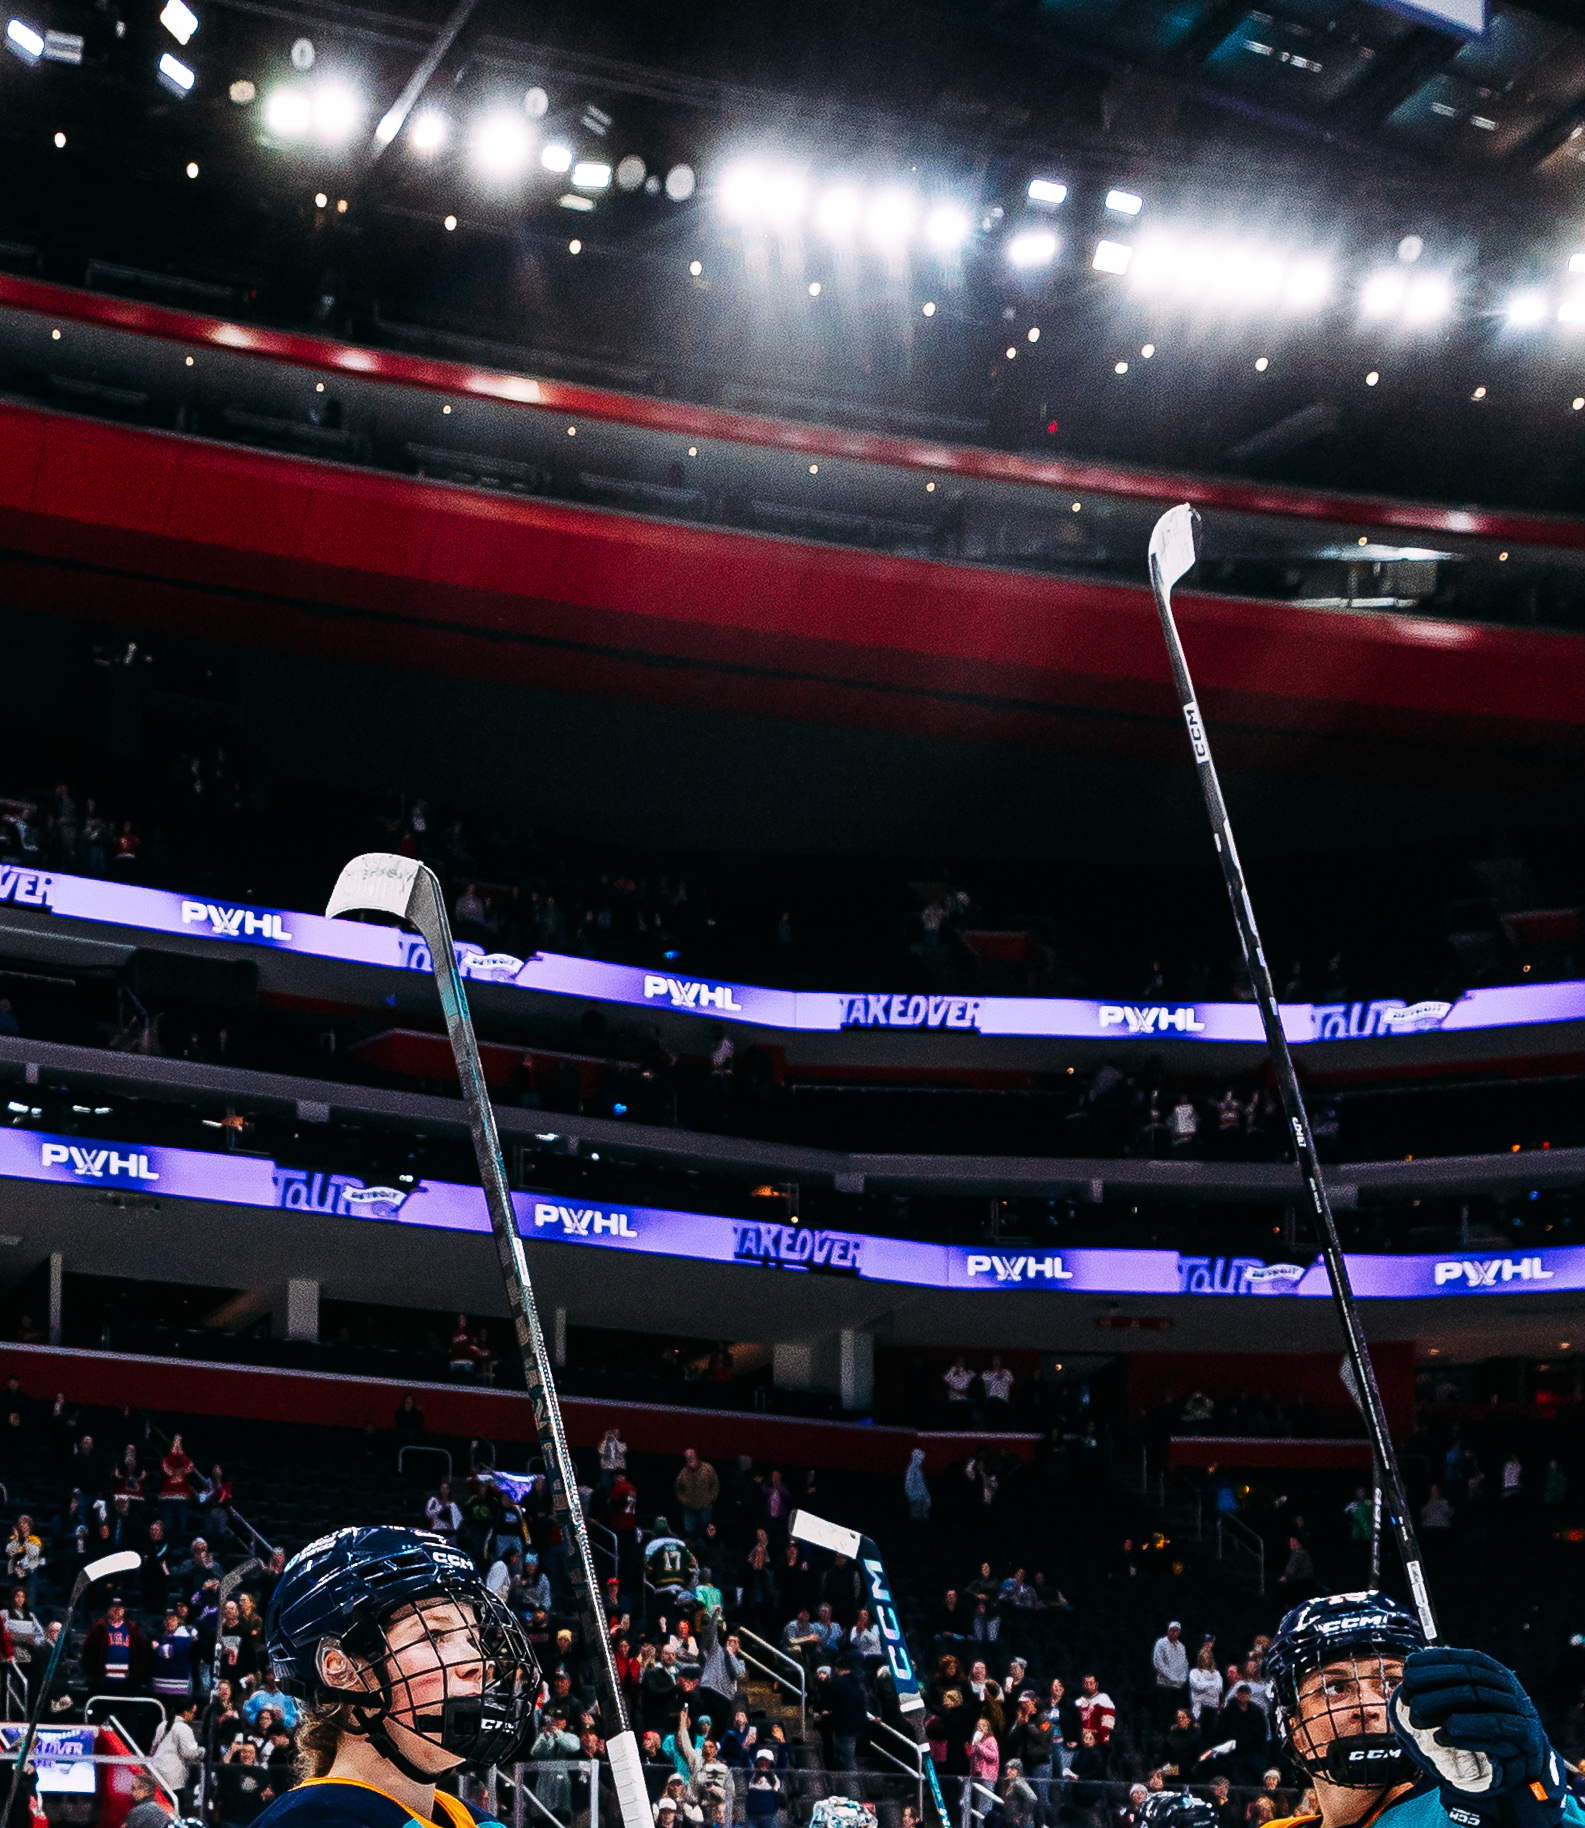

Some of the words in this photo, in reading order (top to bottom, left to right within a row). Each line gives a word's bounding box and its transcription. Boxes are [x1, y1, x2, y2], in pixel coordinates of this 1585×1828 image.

[181, 900, 292, 943] PWHL
[643, 974, 742, 1013] PWHL
[1099, 1006, 1205, 1034] PWHL
[41, 1143, 159, 1180] PWHL
[534, 1202, 638, 1239] PWHL
[966, 1255, 1073, 1282] PWHL
[1434, 1257, 1554, 1287] PWHL
[865, 1559, 913, 1681] CCM
[1349, 1749, 1402, 1761] CCM
